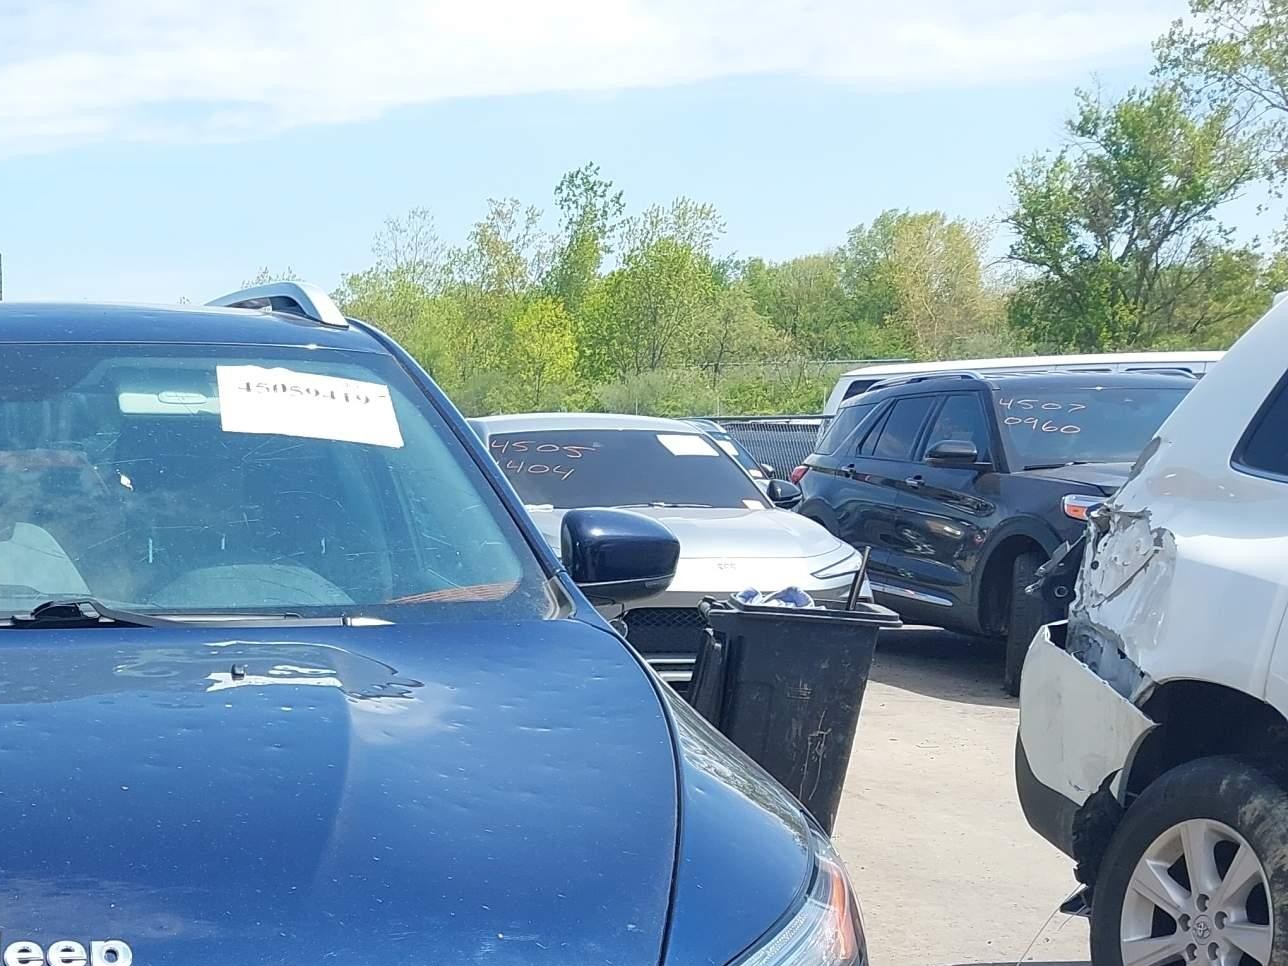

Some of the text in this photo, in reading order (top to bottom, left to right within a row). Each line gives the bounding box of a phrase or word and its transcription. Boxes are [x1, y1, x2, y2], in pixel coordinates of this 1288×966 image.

[999, 398, 1086, 413] 4507
[1004, 417, 1081, 434] 0960
[491, 440, 597, 458] 4505
[496, 459, 575, 481] 404
